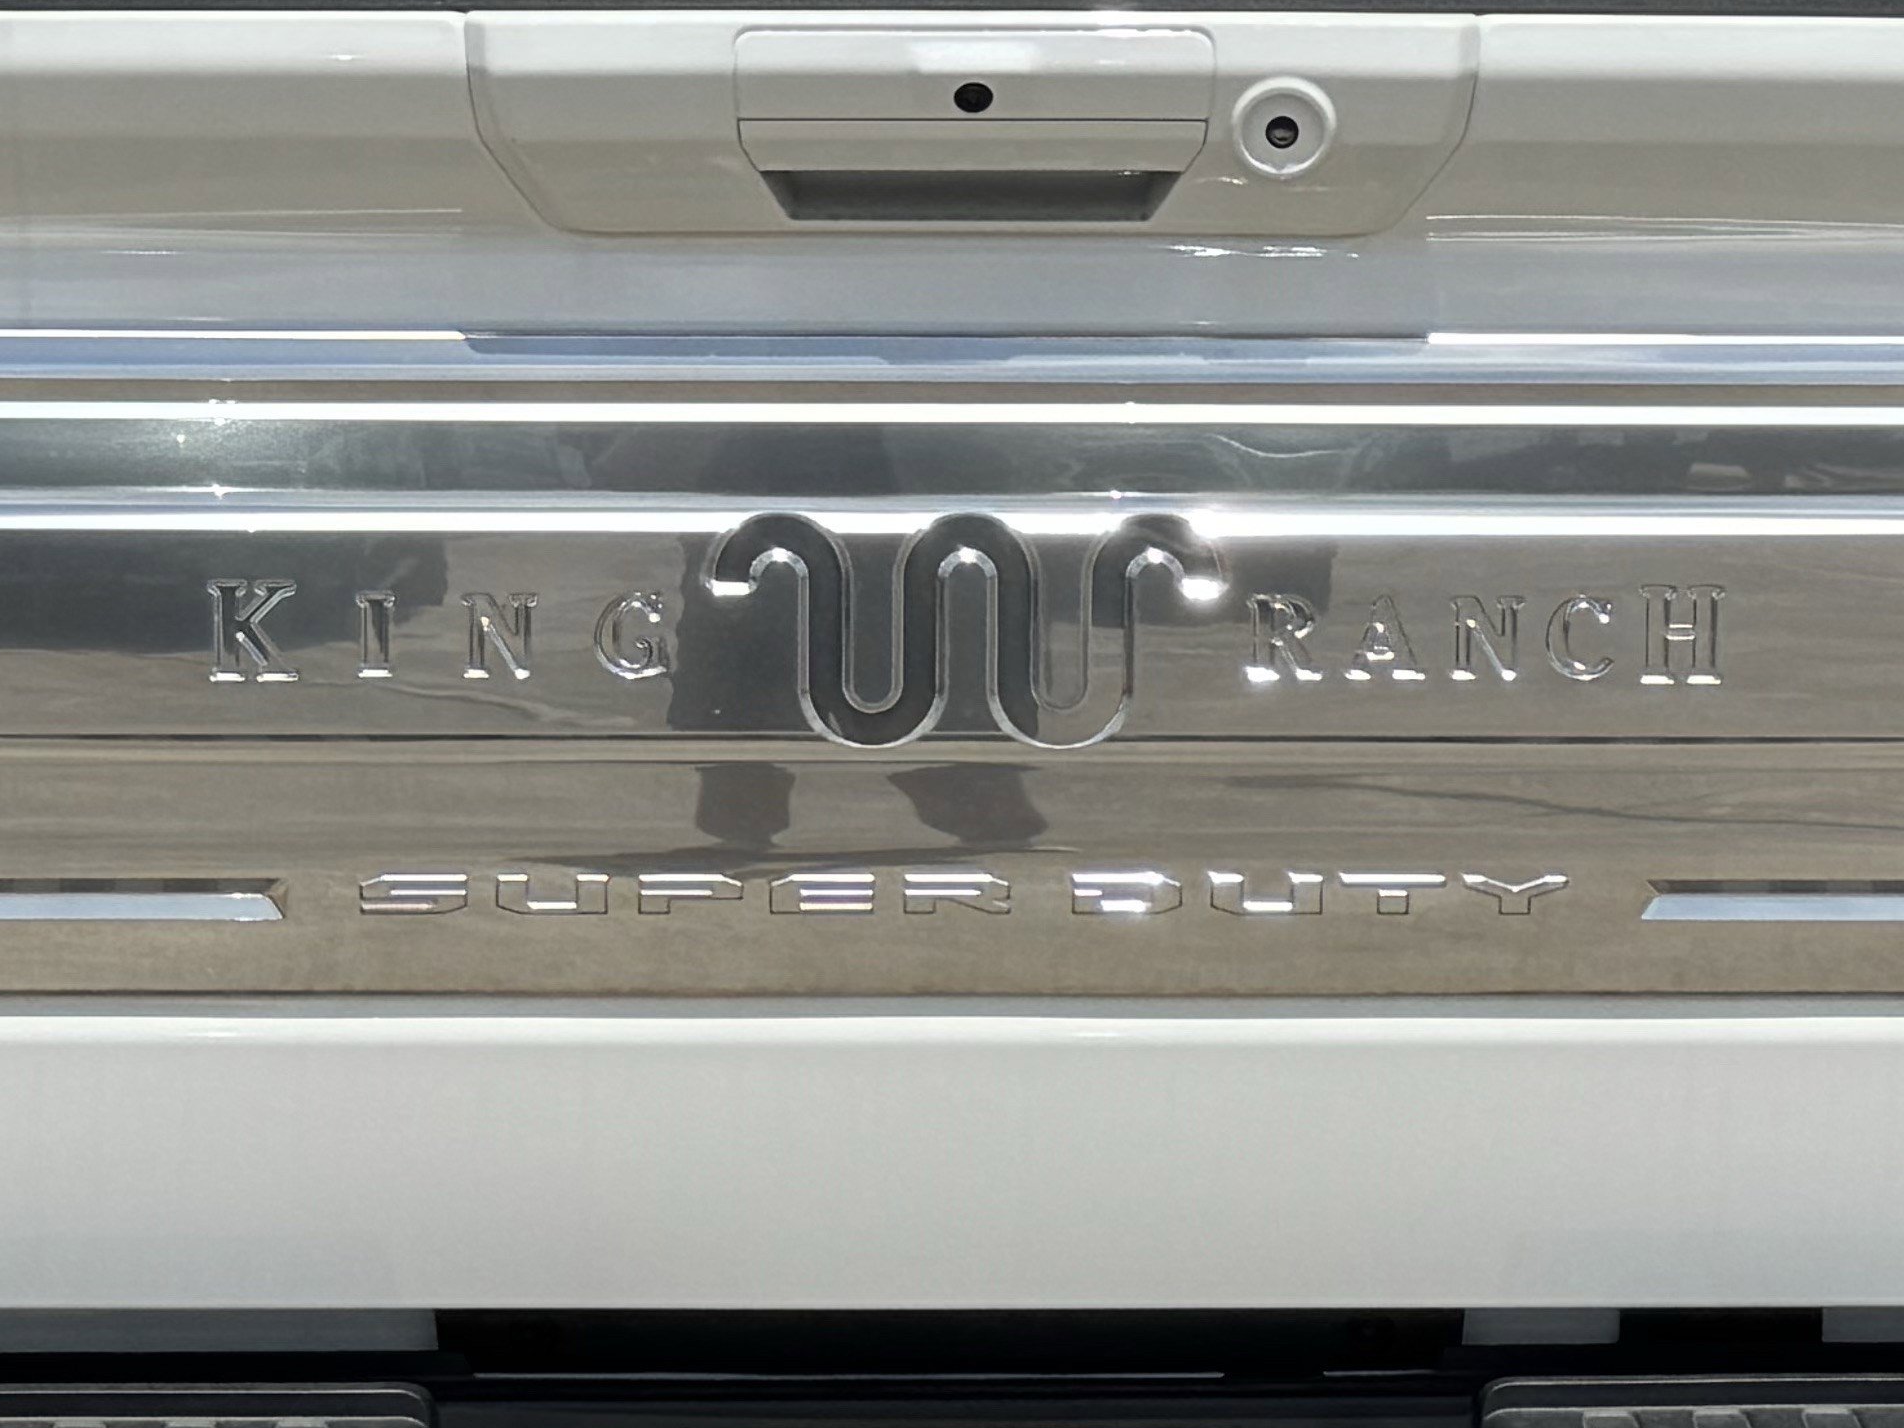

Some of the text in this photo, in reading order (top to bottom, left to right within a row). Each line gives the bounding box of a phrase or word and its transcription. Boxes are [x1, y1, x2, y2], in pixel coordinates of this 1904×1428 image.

[206, 577, 1727, 686] KING RANCH
[358, 871, 1570, 915] SUPER DUTY
